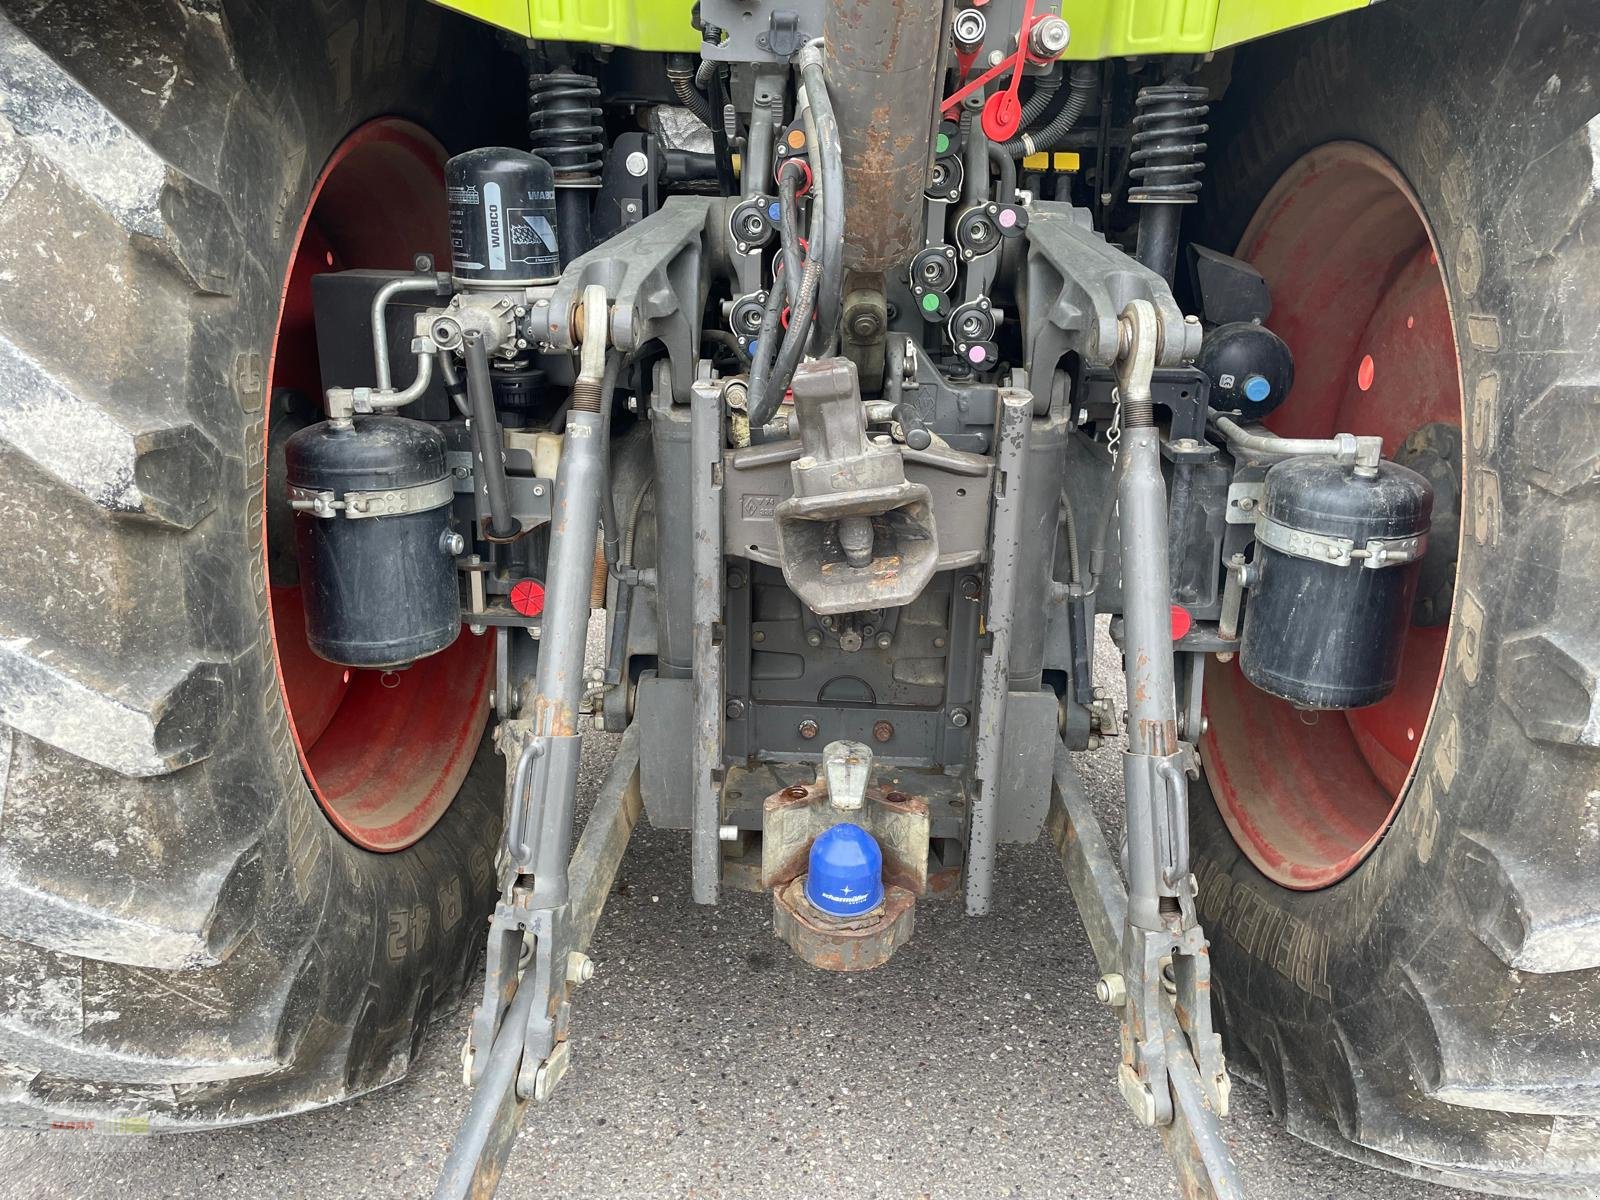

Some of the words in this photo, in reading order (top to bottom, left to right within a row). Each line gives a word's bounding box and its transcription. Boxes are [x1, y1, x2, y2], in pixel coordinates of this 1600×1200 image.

[490, 204, 502, 248] WABCO
[386, 902, 431, 963] 42
[438, 873, 463, 933] R
